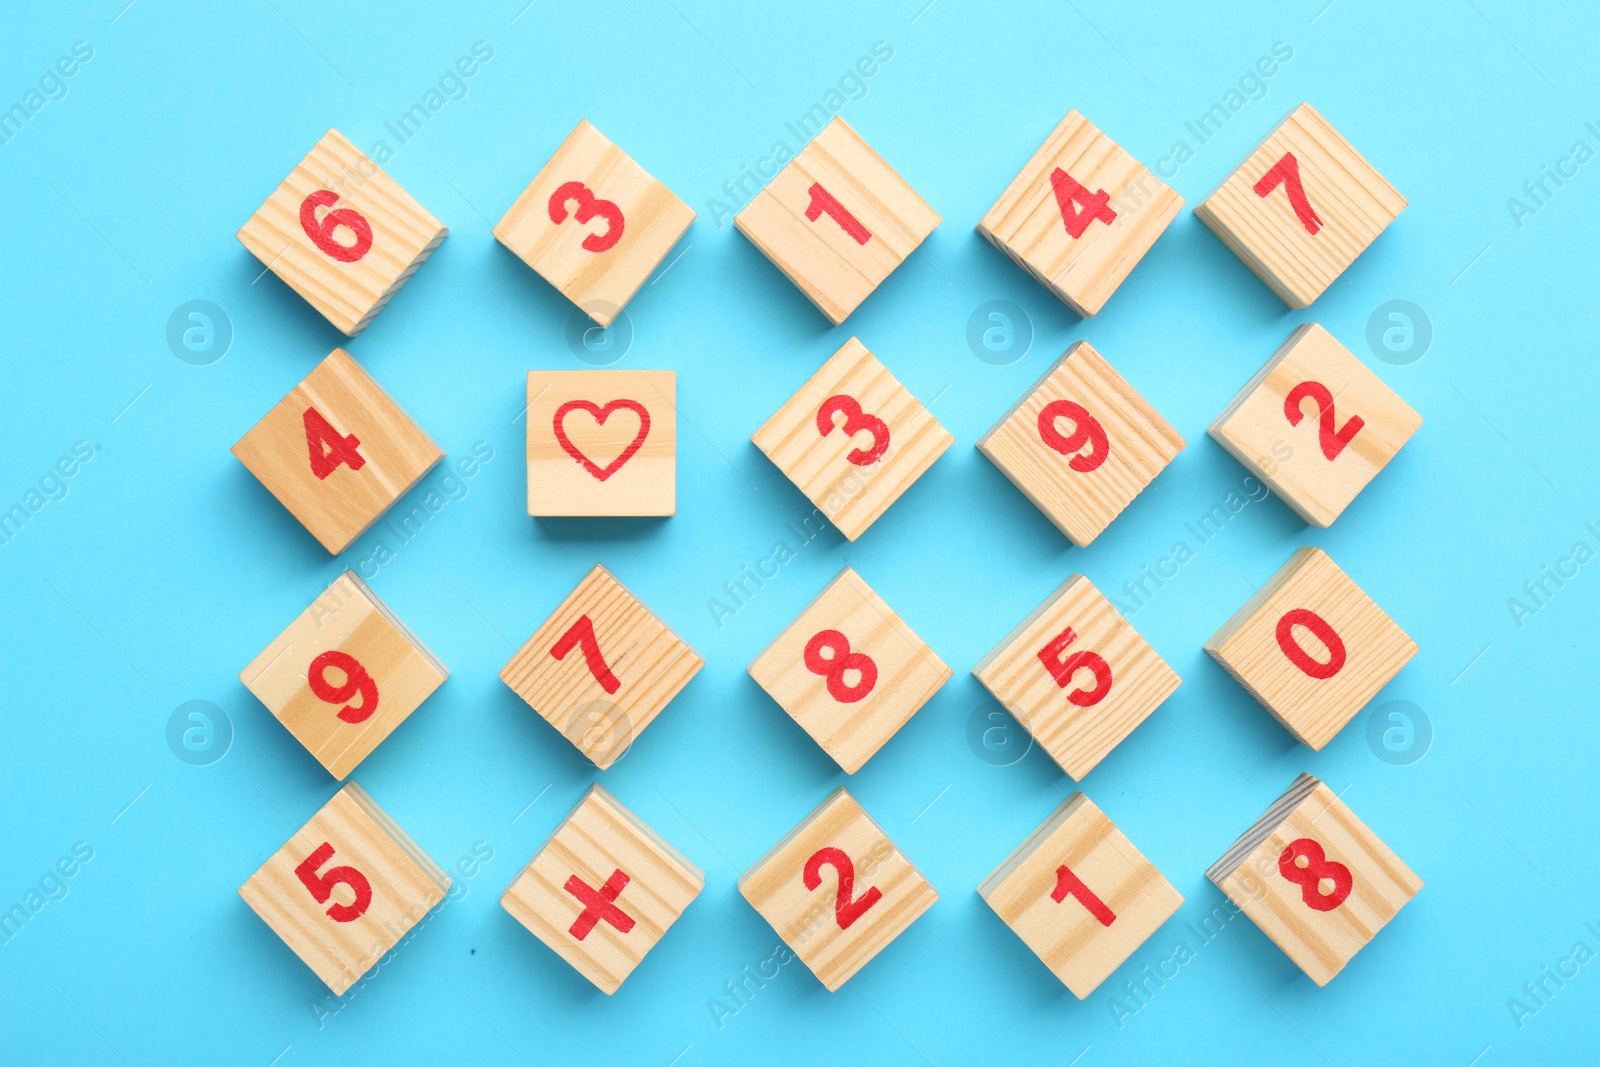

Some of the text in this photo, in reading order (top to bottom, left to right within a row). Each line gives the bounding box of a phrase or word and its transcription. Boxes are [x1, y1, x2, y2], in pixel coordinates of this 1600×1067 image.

[300, 190, 373, 262] 6
[548, 181, 625, 253] 3
[805, 182, 872, 245] 1
[1050, 167, 1117, 239] 4
[1253, 152, 1323, 235] 7
[303, 407, 366, 480] 4
[816, 394, 890, 466] 3
[1038, 400, 1110, 473] 9
[1284, 381, 1364, 461] 2
[550, 614, 621, 695] 7
[804, 629, 878, 703] 8
[1037, 626, 1113, 708] 5
[1276, 608, 1347, 680] 0
[308, 650, 379, 724] 9
[295, 842, 372, 922] 5
[803, 847, 883, 930] 2
[1051, 864, 1116, 926] 1
[1278, 838, 1353, 912] 8
